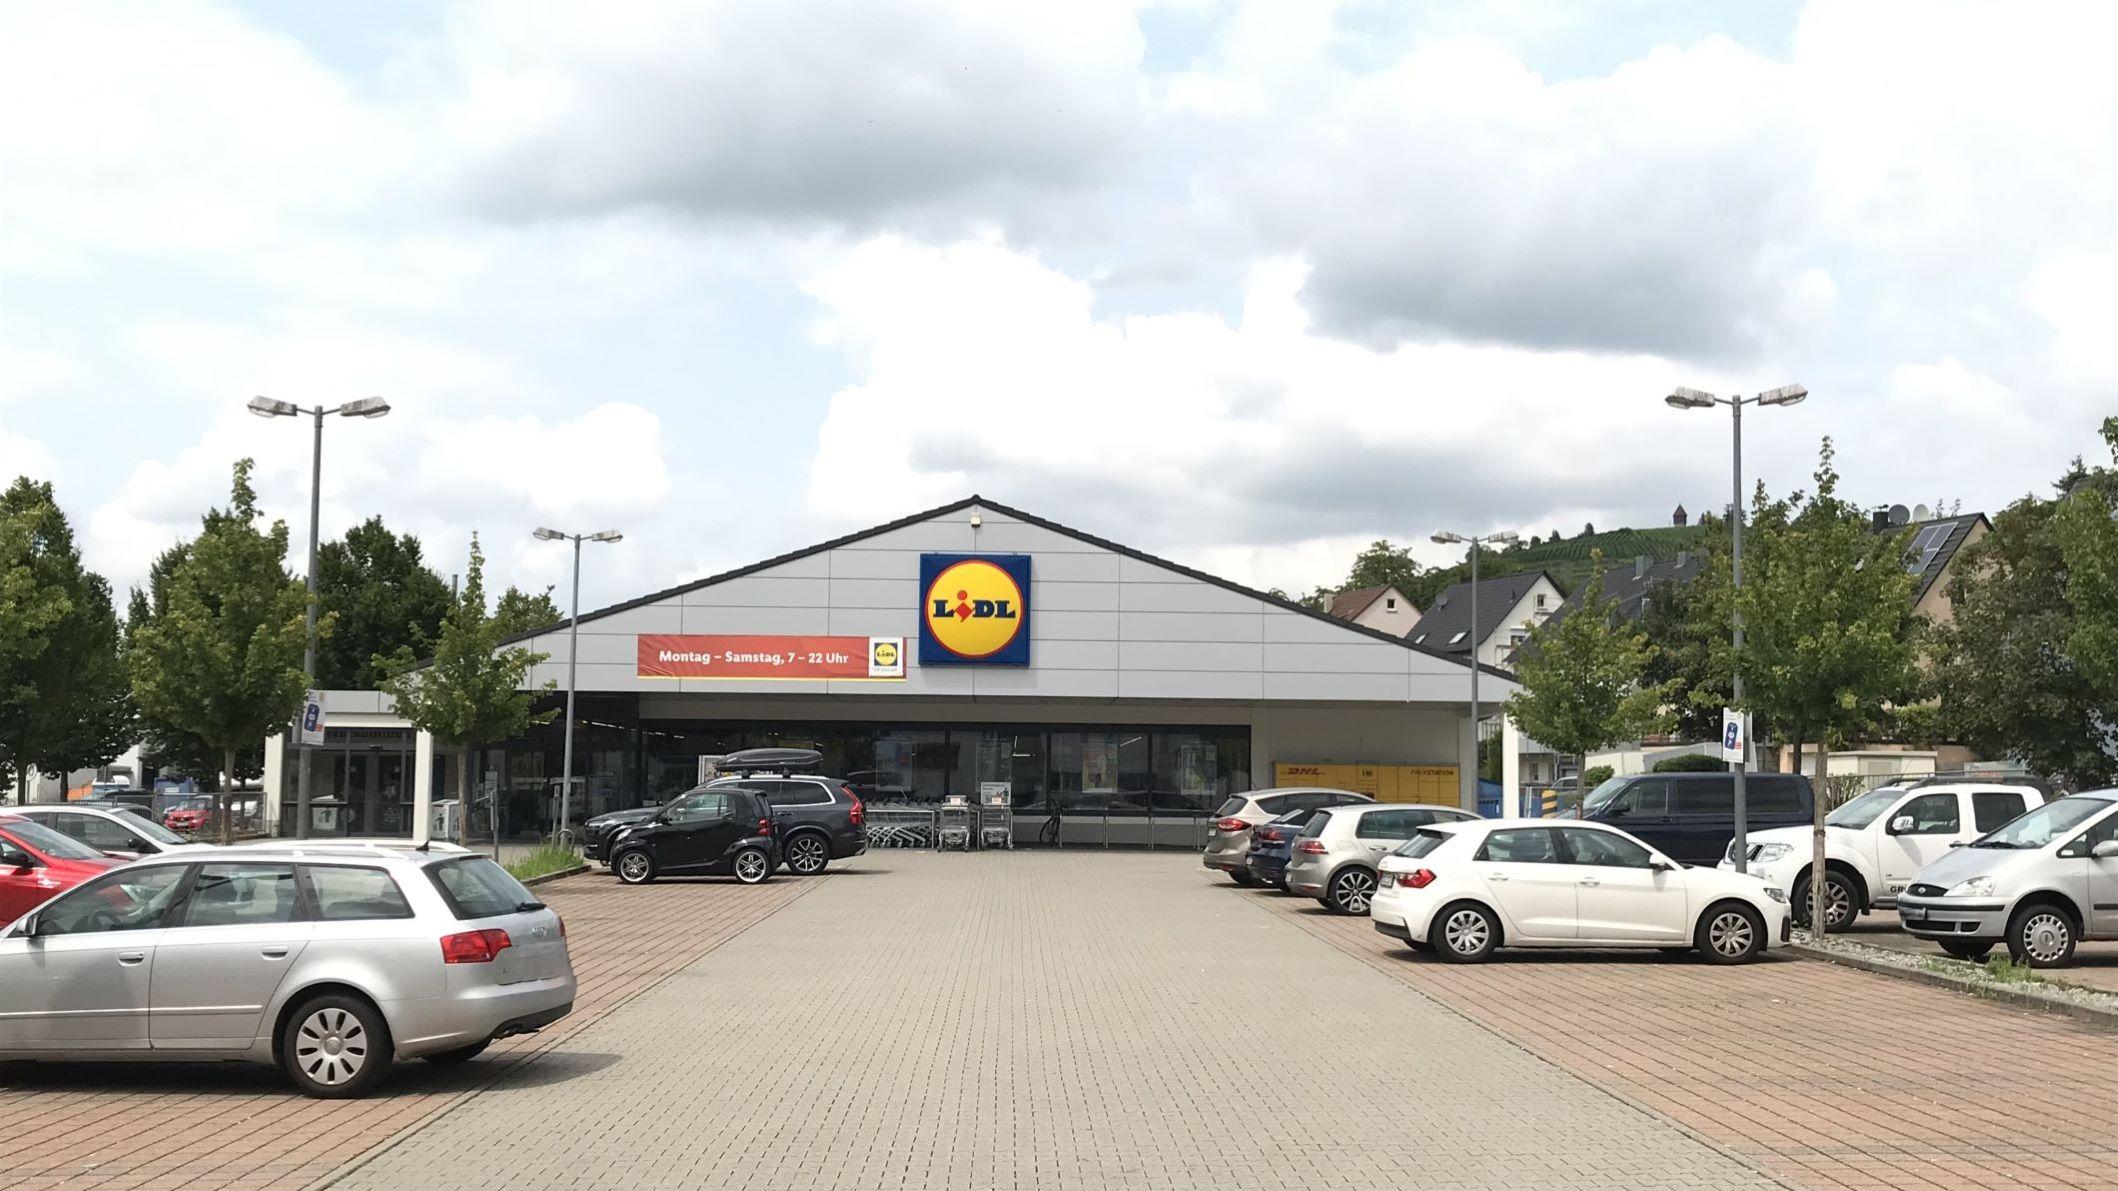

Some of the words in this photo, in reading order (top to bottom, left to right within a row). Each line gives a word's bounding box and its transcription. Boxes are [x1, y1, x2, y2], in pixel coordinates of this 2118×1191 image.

[659, 650, 711, 665] Montag
[725, 651, 785, 666] Samstag,
[787, 652, 796, 663] 7
[808, 652, 823, 664] 22
[825, 652, 849, 664] Uhr
[1287, 767, 1322, 776] DHL
